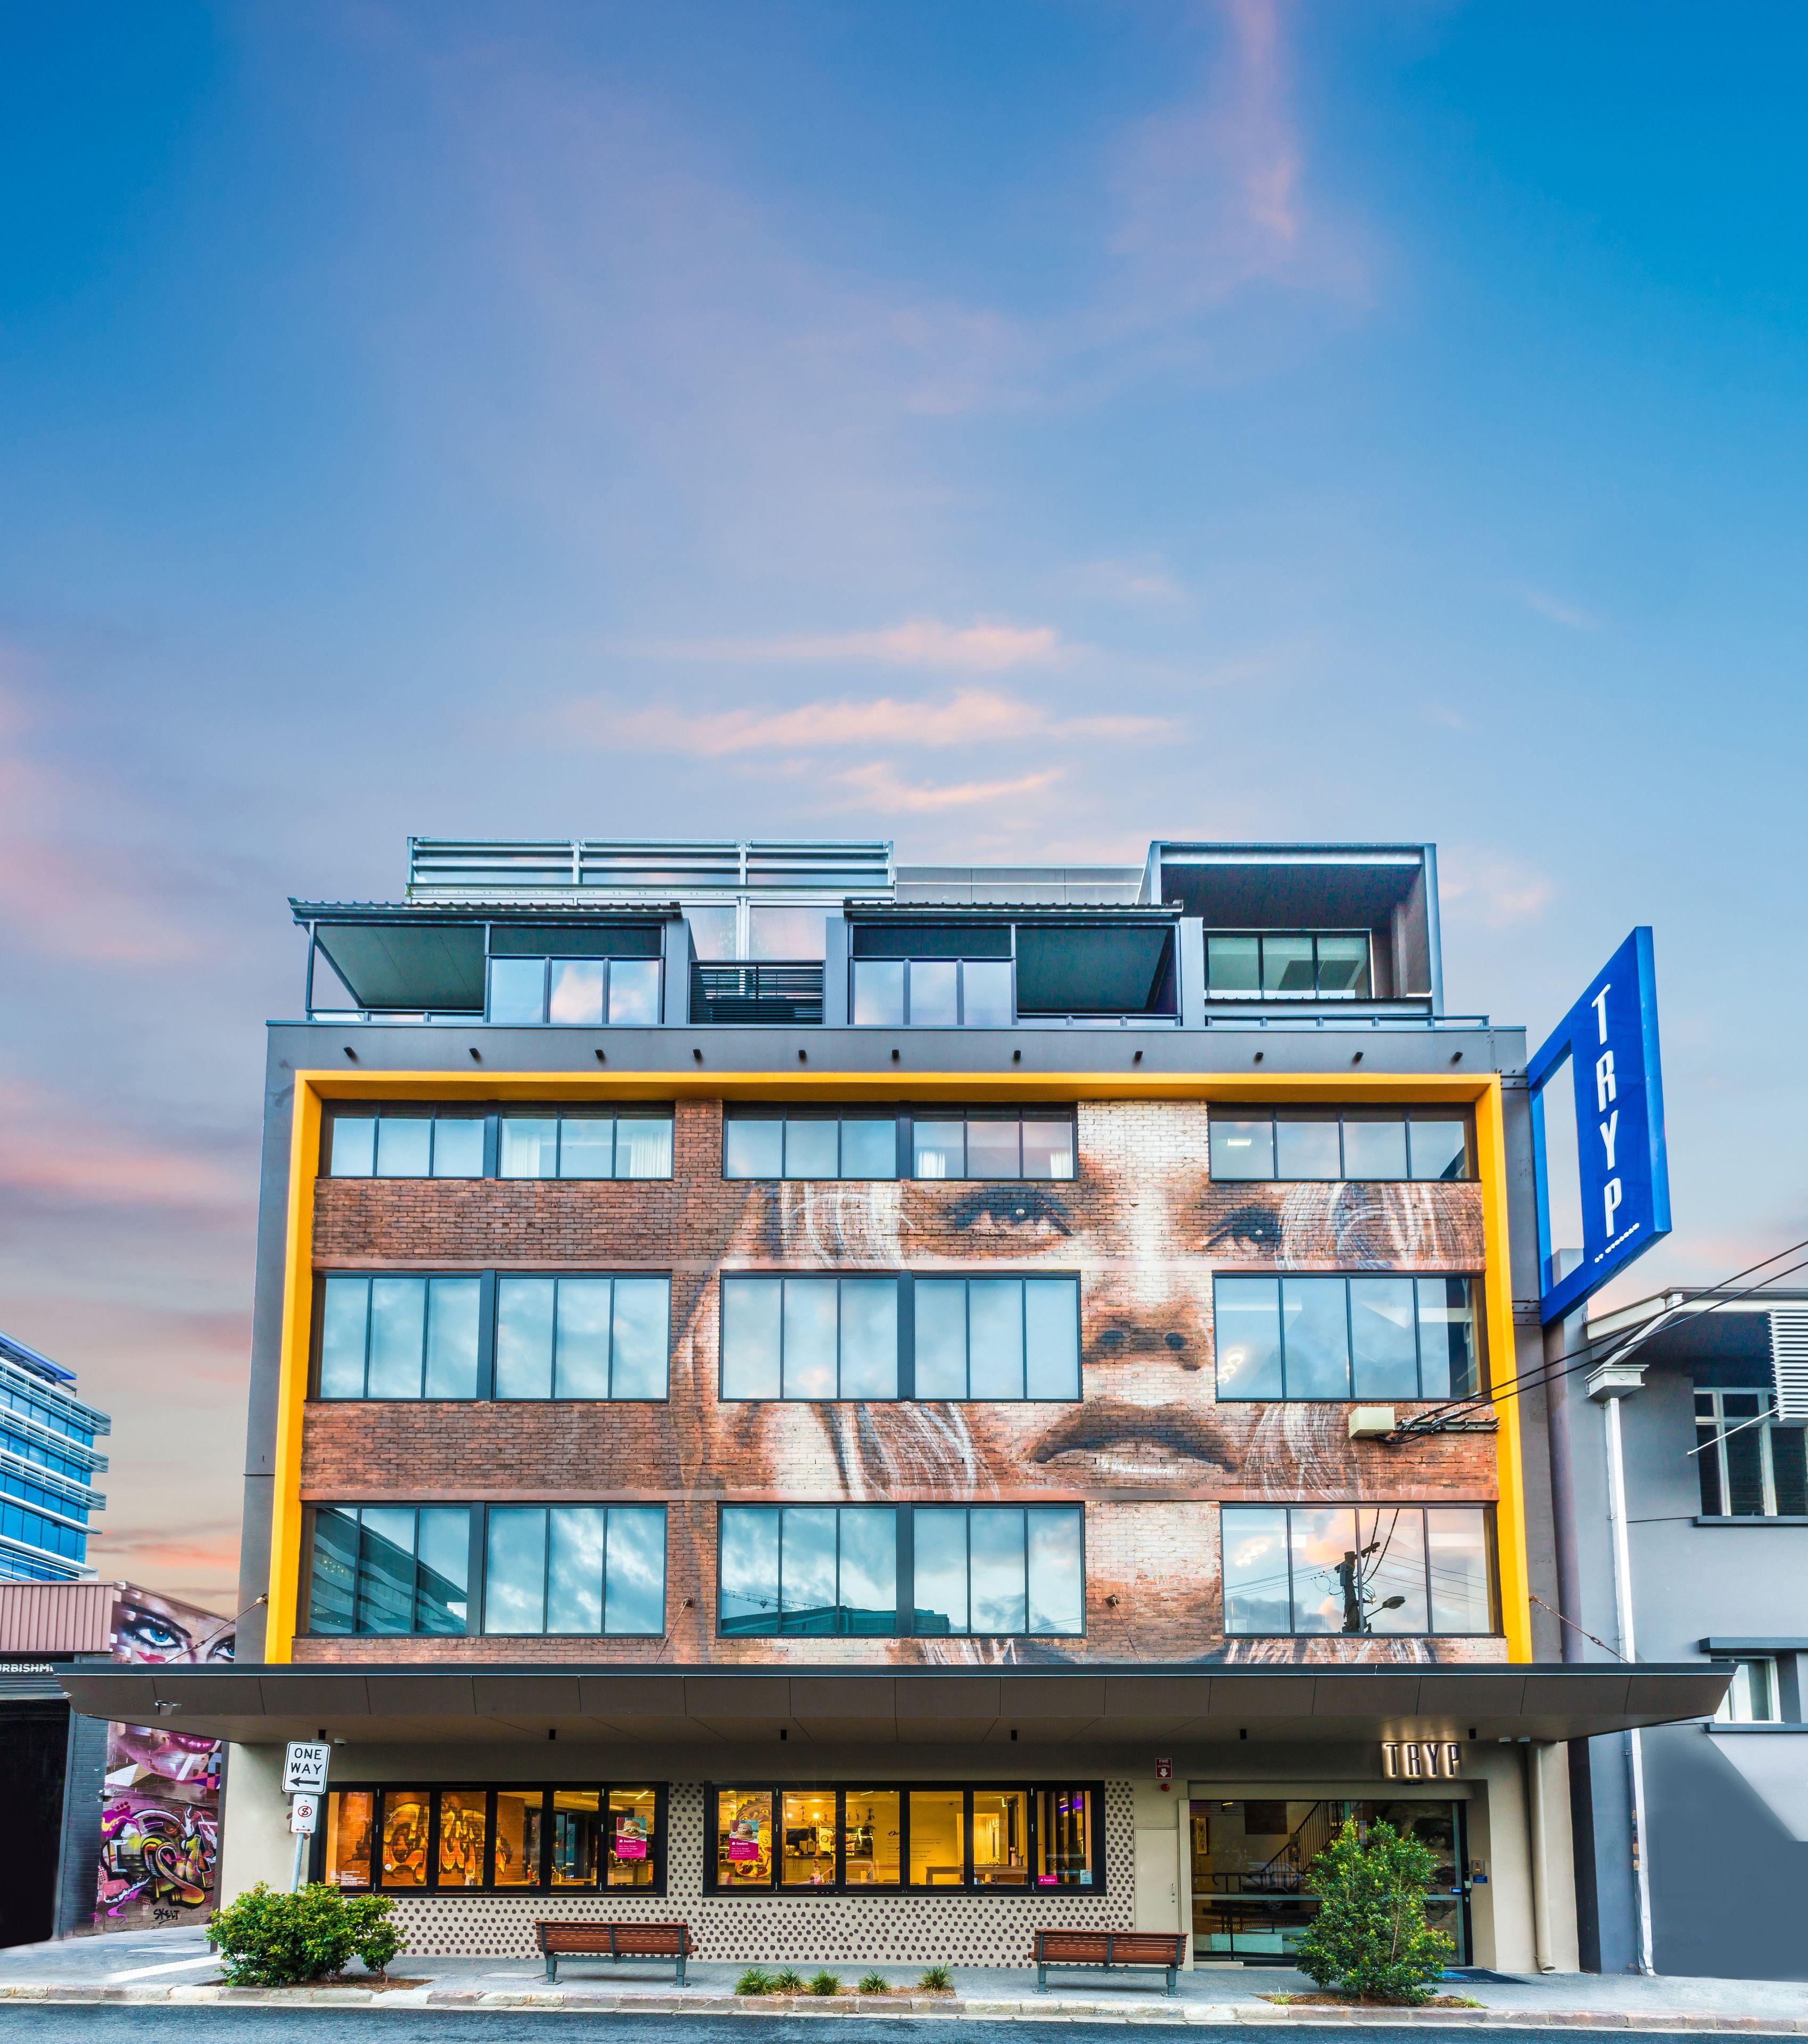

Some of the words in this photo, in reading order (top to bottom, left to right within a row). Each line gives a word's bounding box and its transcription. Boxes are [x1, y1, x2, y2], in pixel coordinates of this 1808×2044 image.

[1591, 983, 1622, 1238] TRYP
[294, 1748, 322, 1760] ONE
[1386, 1744, 1459, 1775] TRYP
[291, 1762, 323, 1775] WAY
